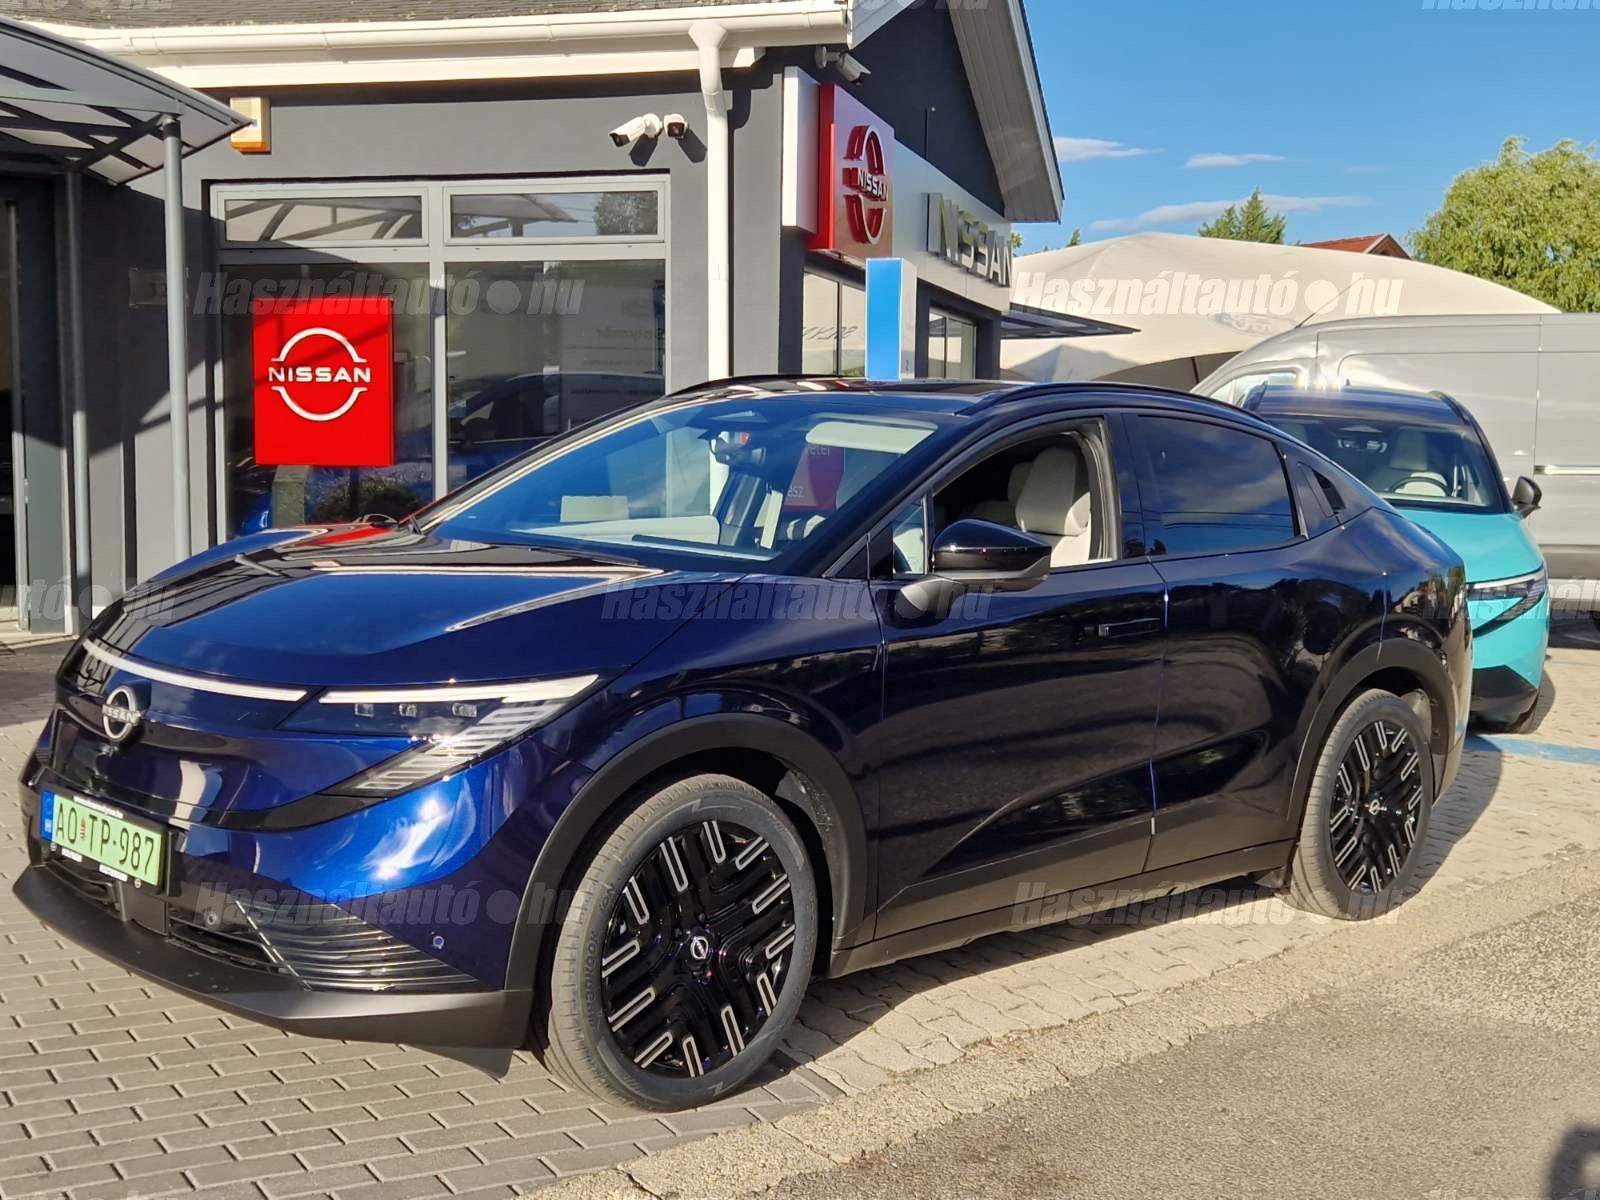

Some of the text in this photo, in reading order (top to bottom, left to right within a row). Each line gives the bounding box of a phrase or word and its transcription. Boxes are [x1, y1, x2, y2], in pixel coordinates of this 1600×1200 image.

[858, 168, 888, 202] NISSAN
[926, 193, 1012, 288] NISSAN
[268, 366, 371, 383] NISSAN
